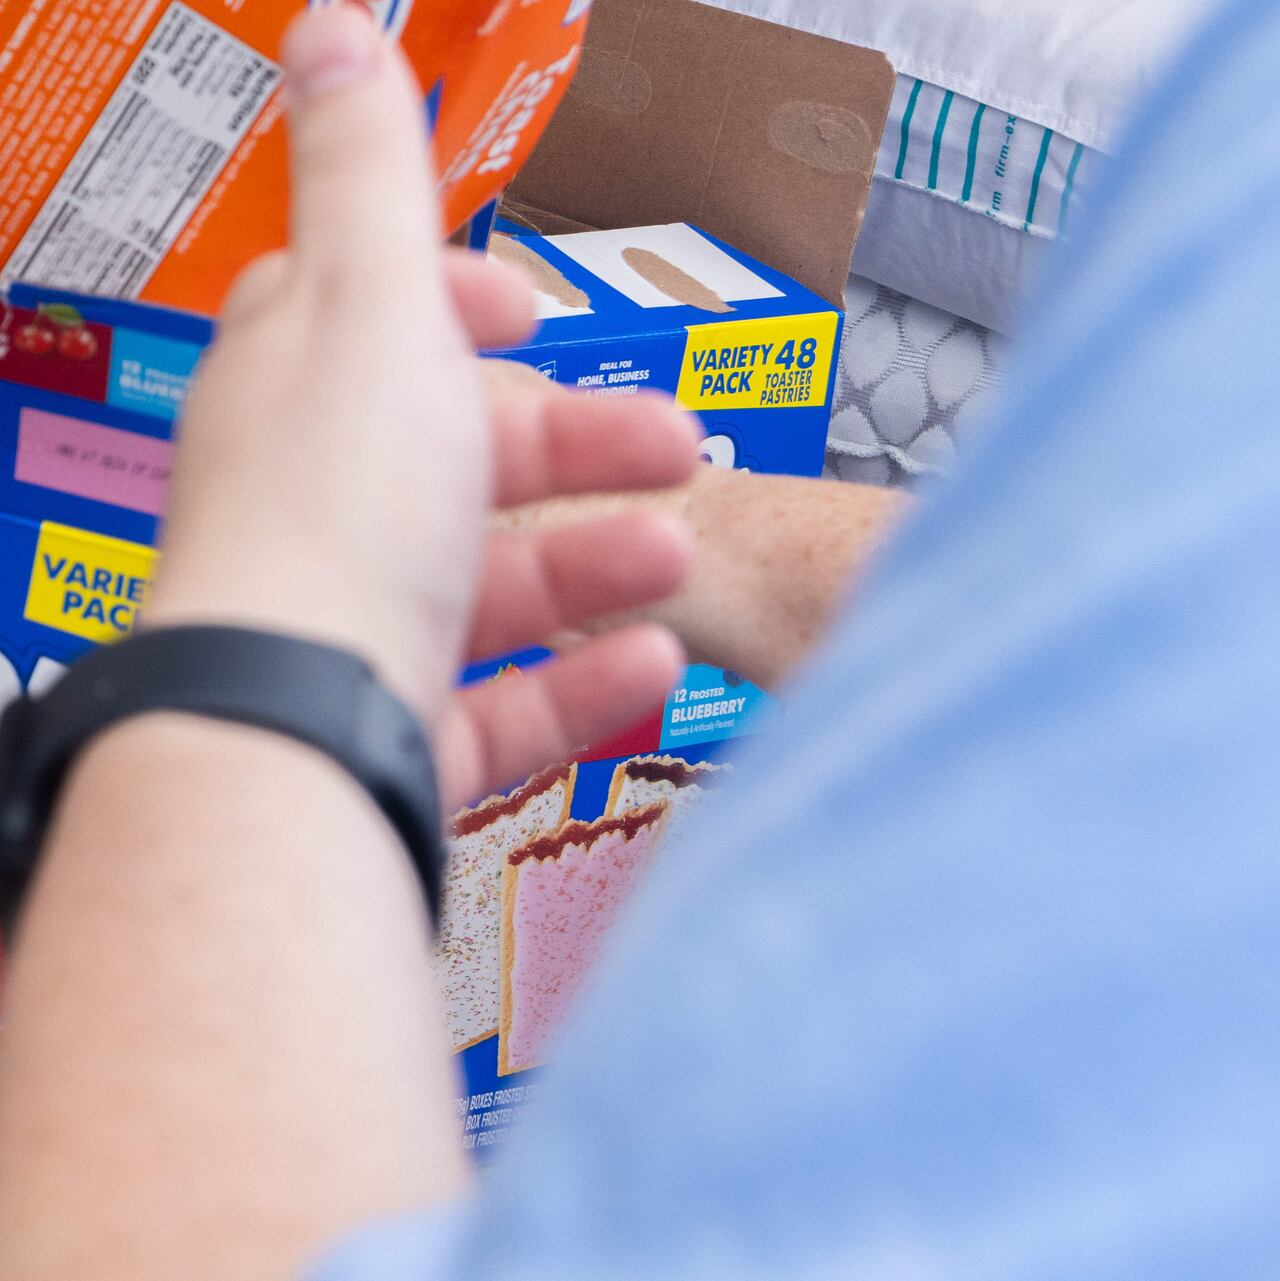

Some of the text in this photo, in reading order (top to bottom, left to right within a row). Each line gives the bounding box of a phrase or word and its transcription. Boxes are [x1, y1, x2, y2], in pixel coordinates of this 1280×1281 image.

[994, 114, 1017, 179] firm-ex
[599, 359, 633, 372] IDEAL FOR
[692, 343, 774, 373] VARIETY
[775, 337, 818, 371] 48
[577, 369, 650, 388] HOME, BUSINESS
[700, 369, 755, 396] PACK
[765, 369, 813, 389] TOASTER
[759, 386, 811, 407] PASTRIES
[42, 553, 148, 603] VARIE
[61, 590, 141, 633] PAC
[673, 686, 725, 703] 12 FROSTED
[671, 697, 747, 724] BLUEBERRY
[469, 1091, 495, 1111] BOXES
[492, 1086, 525, 1107] FROSTED
[465, 1113, 482, 1131] BOX
